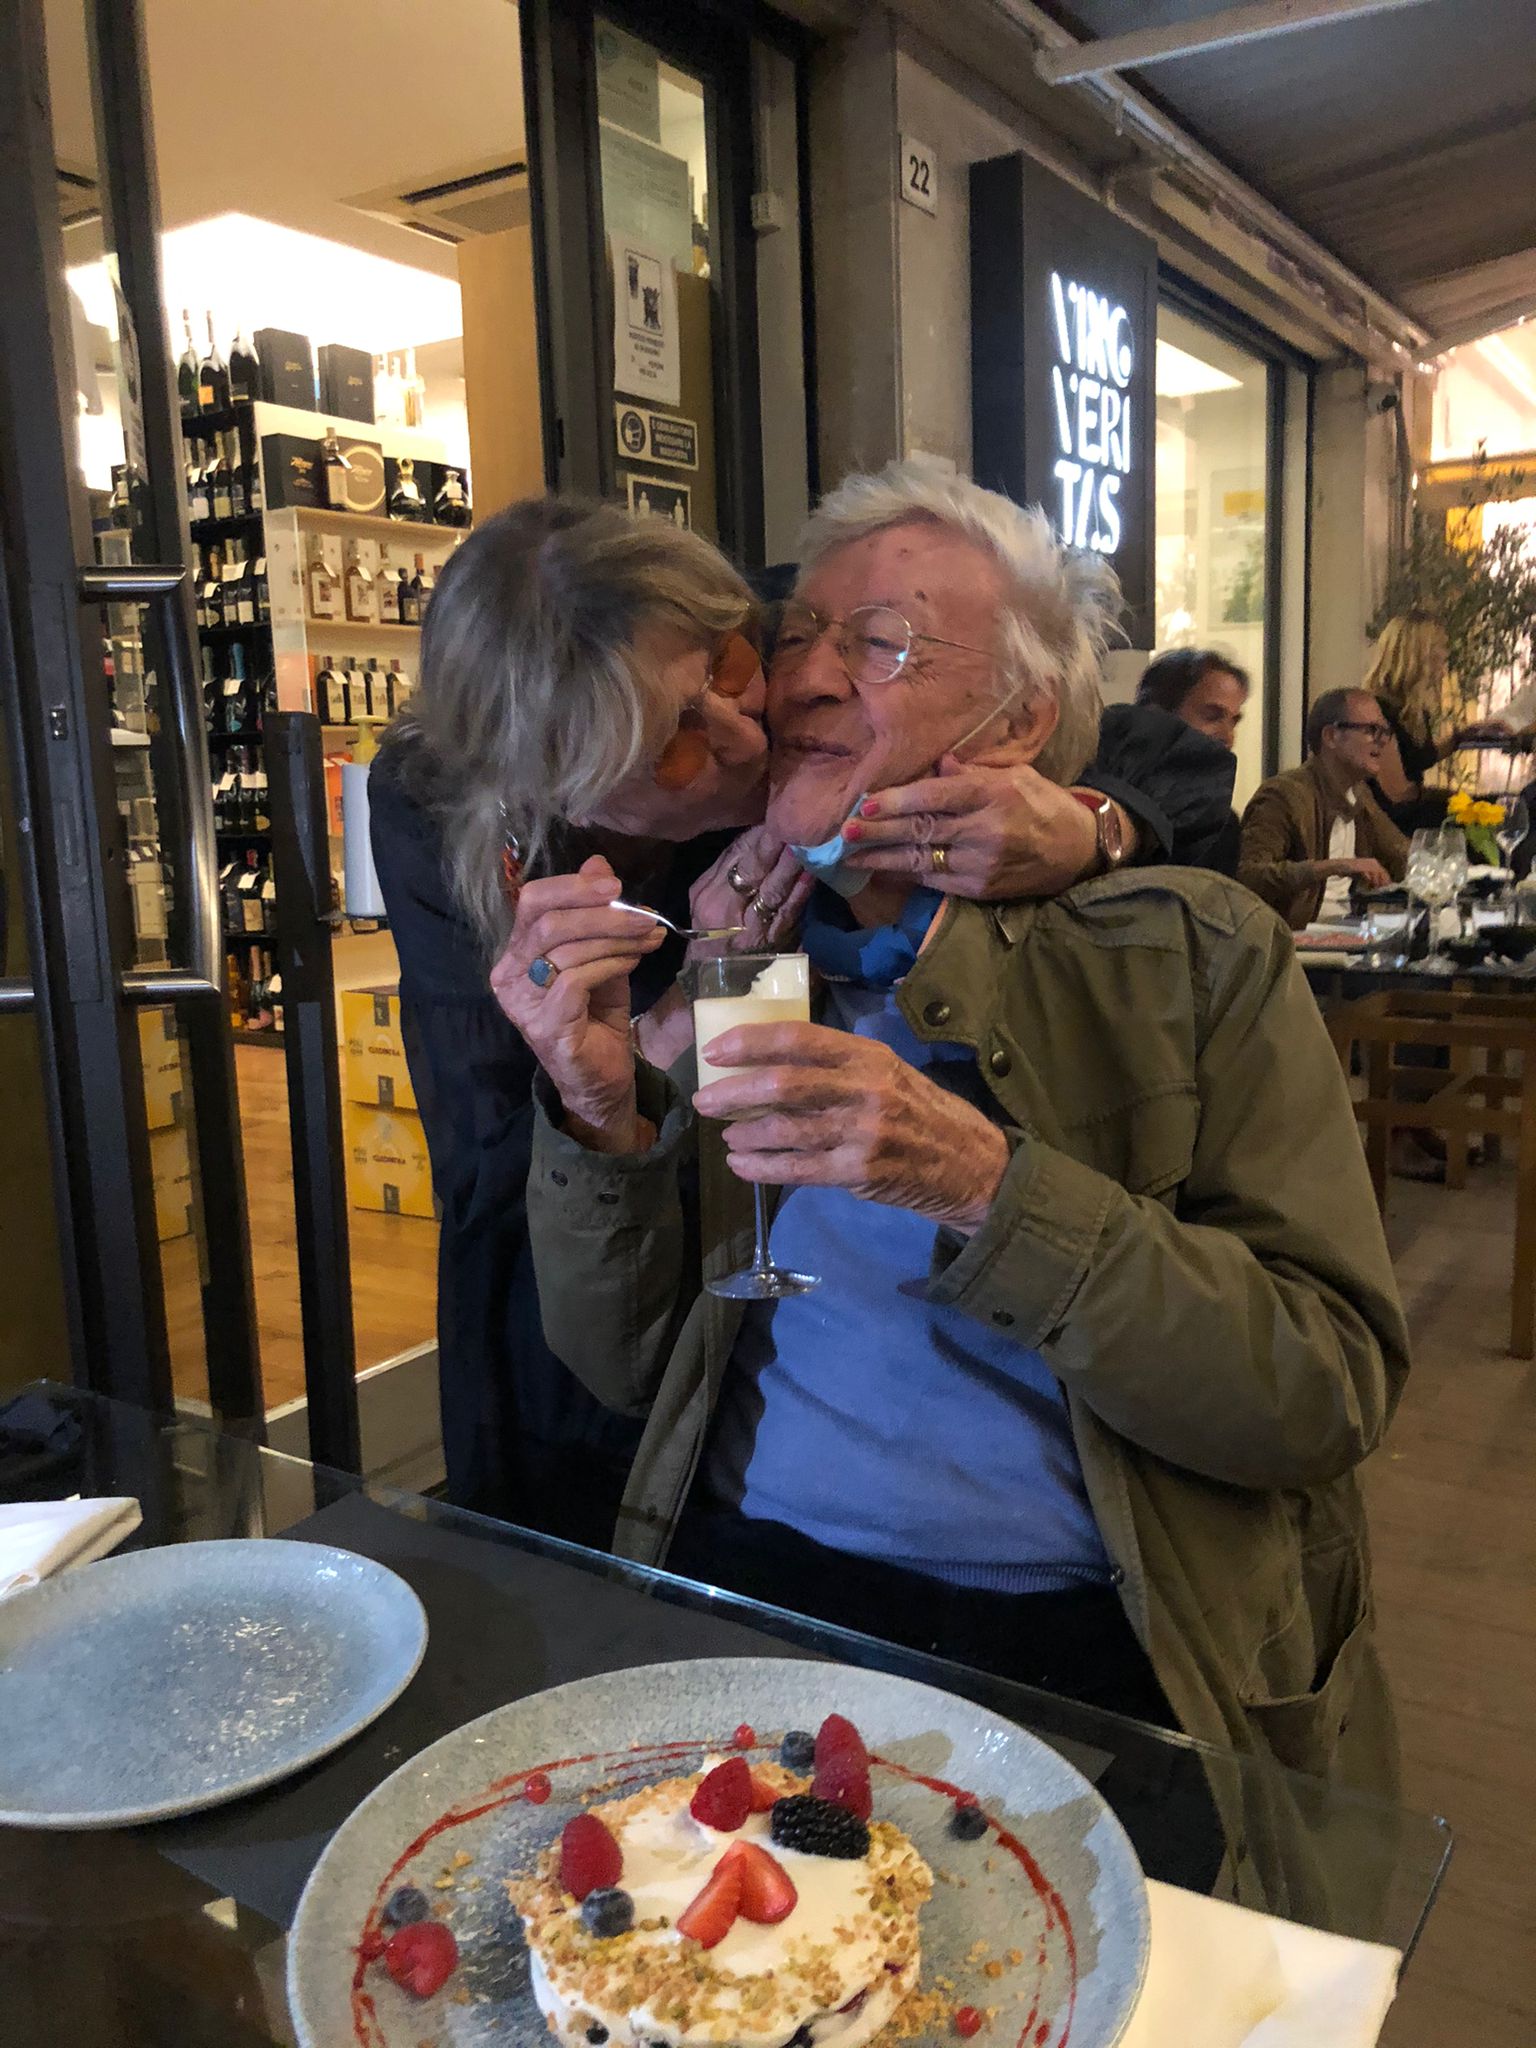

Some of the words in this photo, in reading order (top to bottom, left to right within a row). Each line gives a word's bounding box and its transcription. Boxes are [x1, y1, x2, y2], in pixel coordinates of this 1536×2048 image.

[909, 154, 930, 197] 22
[1050, 270, 1135, 389] VINO
[1051, 364, 1131, 474] VERI
[1054, 458, 1121, 555] TAS
